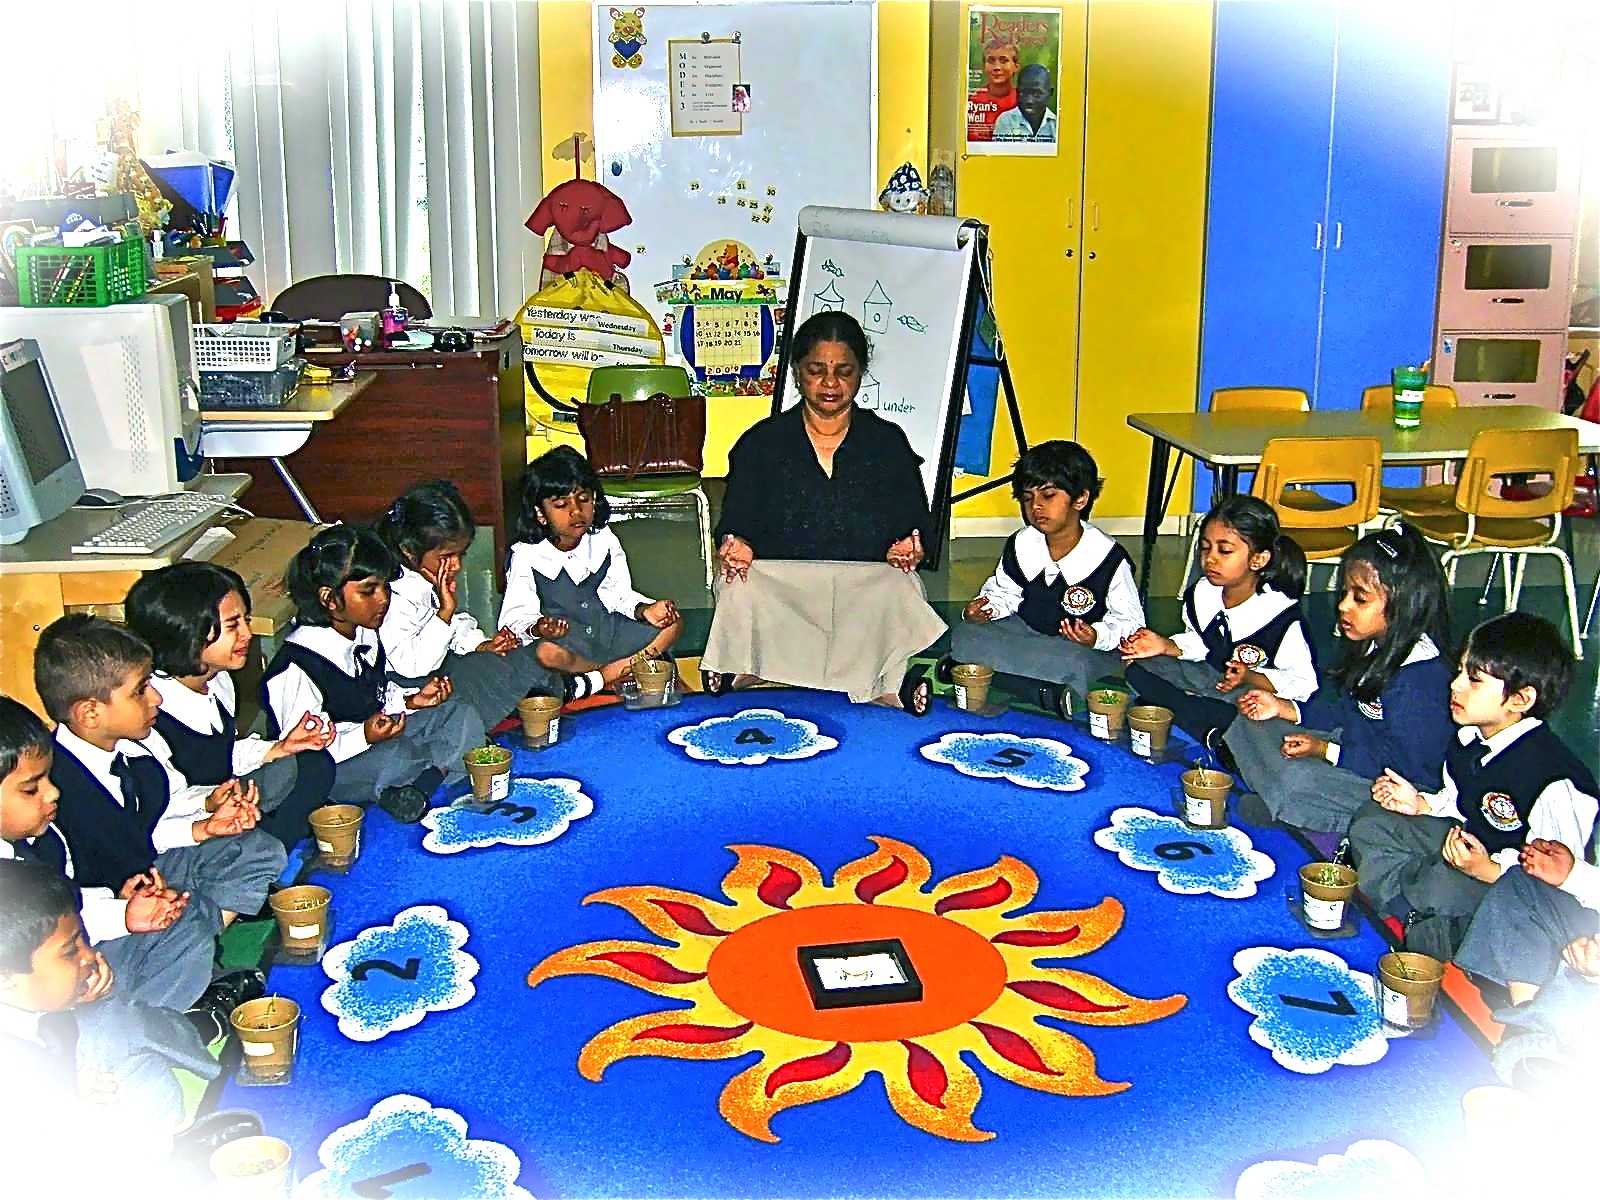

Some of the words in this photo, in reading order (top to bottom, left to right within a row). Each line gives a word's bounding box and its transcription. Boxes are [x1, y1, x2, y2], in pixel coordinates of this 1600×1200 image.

[967, 100, 998, 112] Ryan's
[967, 113, 986, 123] Well
[710, 288, 743, 303] May
[527, 307, 577, 323] Yesterday
[597, 321, 637, 333] Wednesday
[534, 328, 565, 342] Today
[523, 345, 569, 358] Tomorrow
[572, 351, 589, 360] will
[612, 344, 643, 354] Thursday
[883, 397, 916, 413] under
[985, 748, 1034, 768] 5
[352, 958, 421, 981] 2
